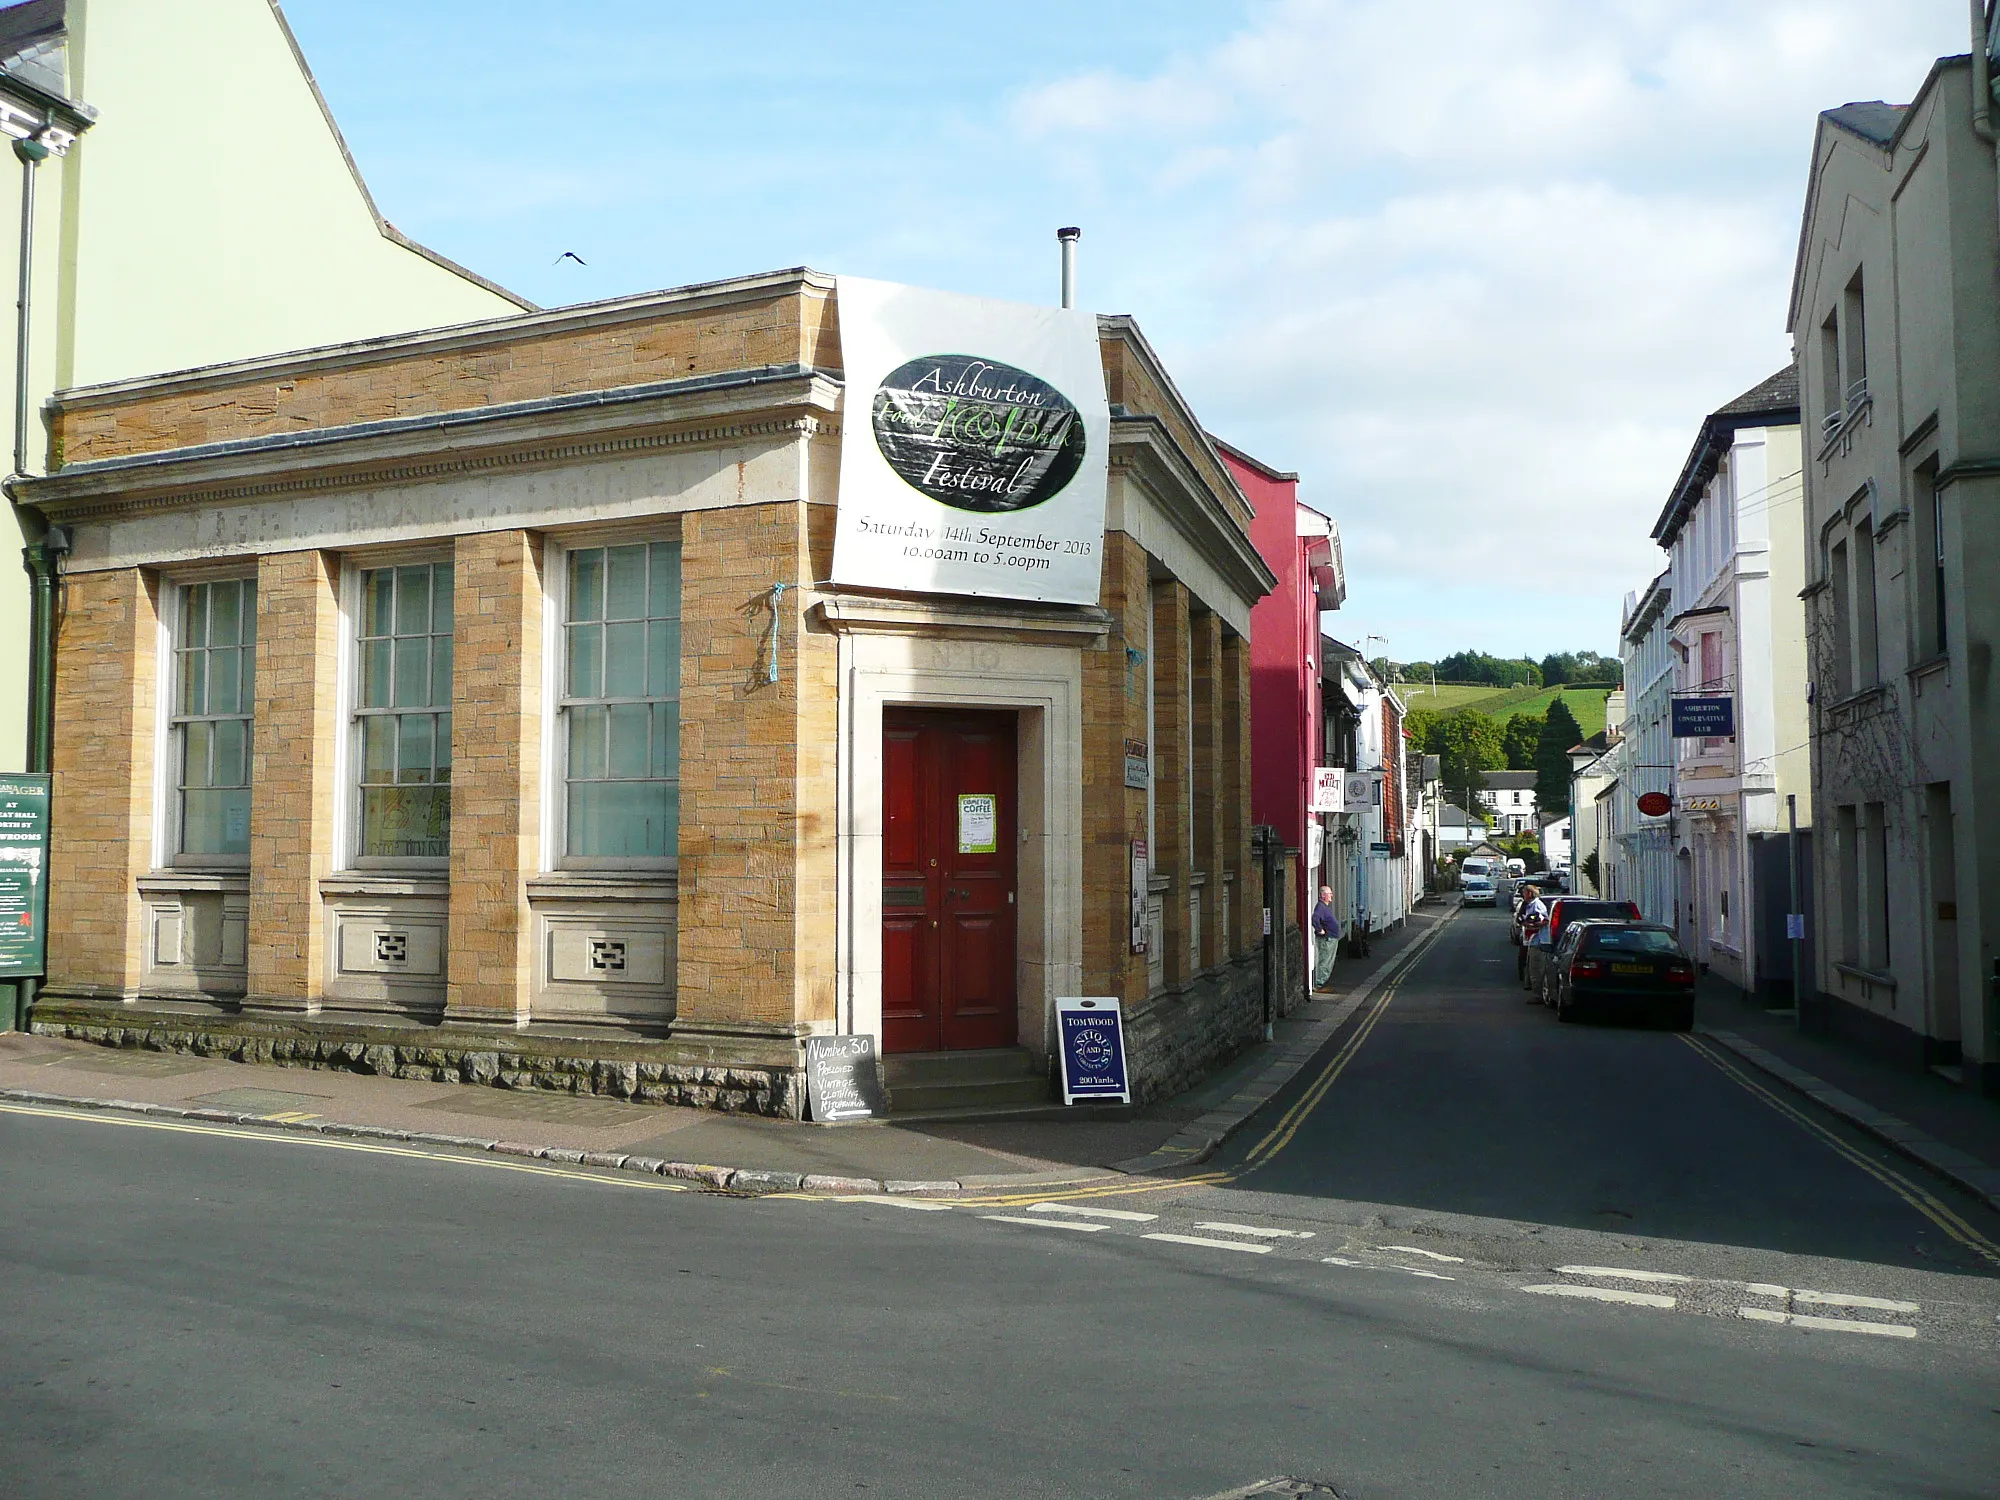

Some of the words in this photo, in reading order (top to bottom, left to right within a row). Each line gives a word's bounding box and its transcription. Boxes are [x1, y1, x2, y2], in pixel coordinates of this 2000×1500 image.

[912, 361, 1046, 406] Ashburton
[877, 400, 927, 428] Food
[1015, 420, 1081, 447] Drink
[922, 451, 1034, 494] Festival
[857, 515, 934, 540] Saturday
[945, 526, 971, 543] 14th
[976, 527, 1060, 551] September
[1063, 540, 1092, 555] 2013
[903, 546, 968, 562] 10.00am
[973, 551, 990, 564] to
[993, 552, 1050, 571] 5.00pm
[963, 805, 991, 813] COFFEE
[1067, 1018, 1087, 1026] TOM
[1087, 1018, 1114, 1026] WOOD
[808, 1039, 849, 1060] Number
[849, 1038, 869, 1054] 30
[1075, 1031, 1111, 1065] ANTIQUES
[1086, 1046, 1101, 1054] AND
[817, 1078, 857, 1090] VINTAGE
[1093, 1076, 1114, 1084] Yards
